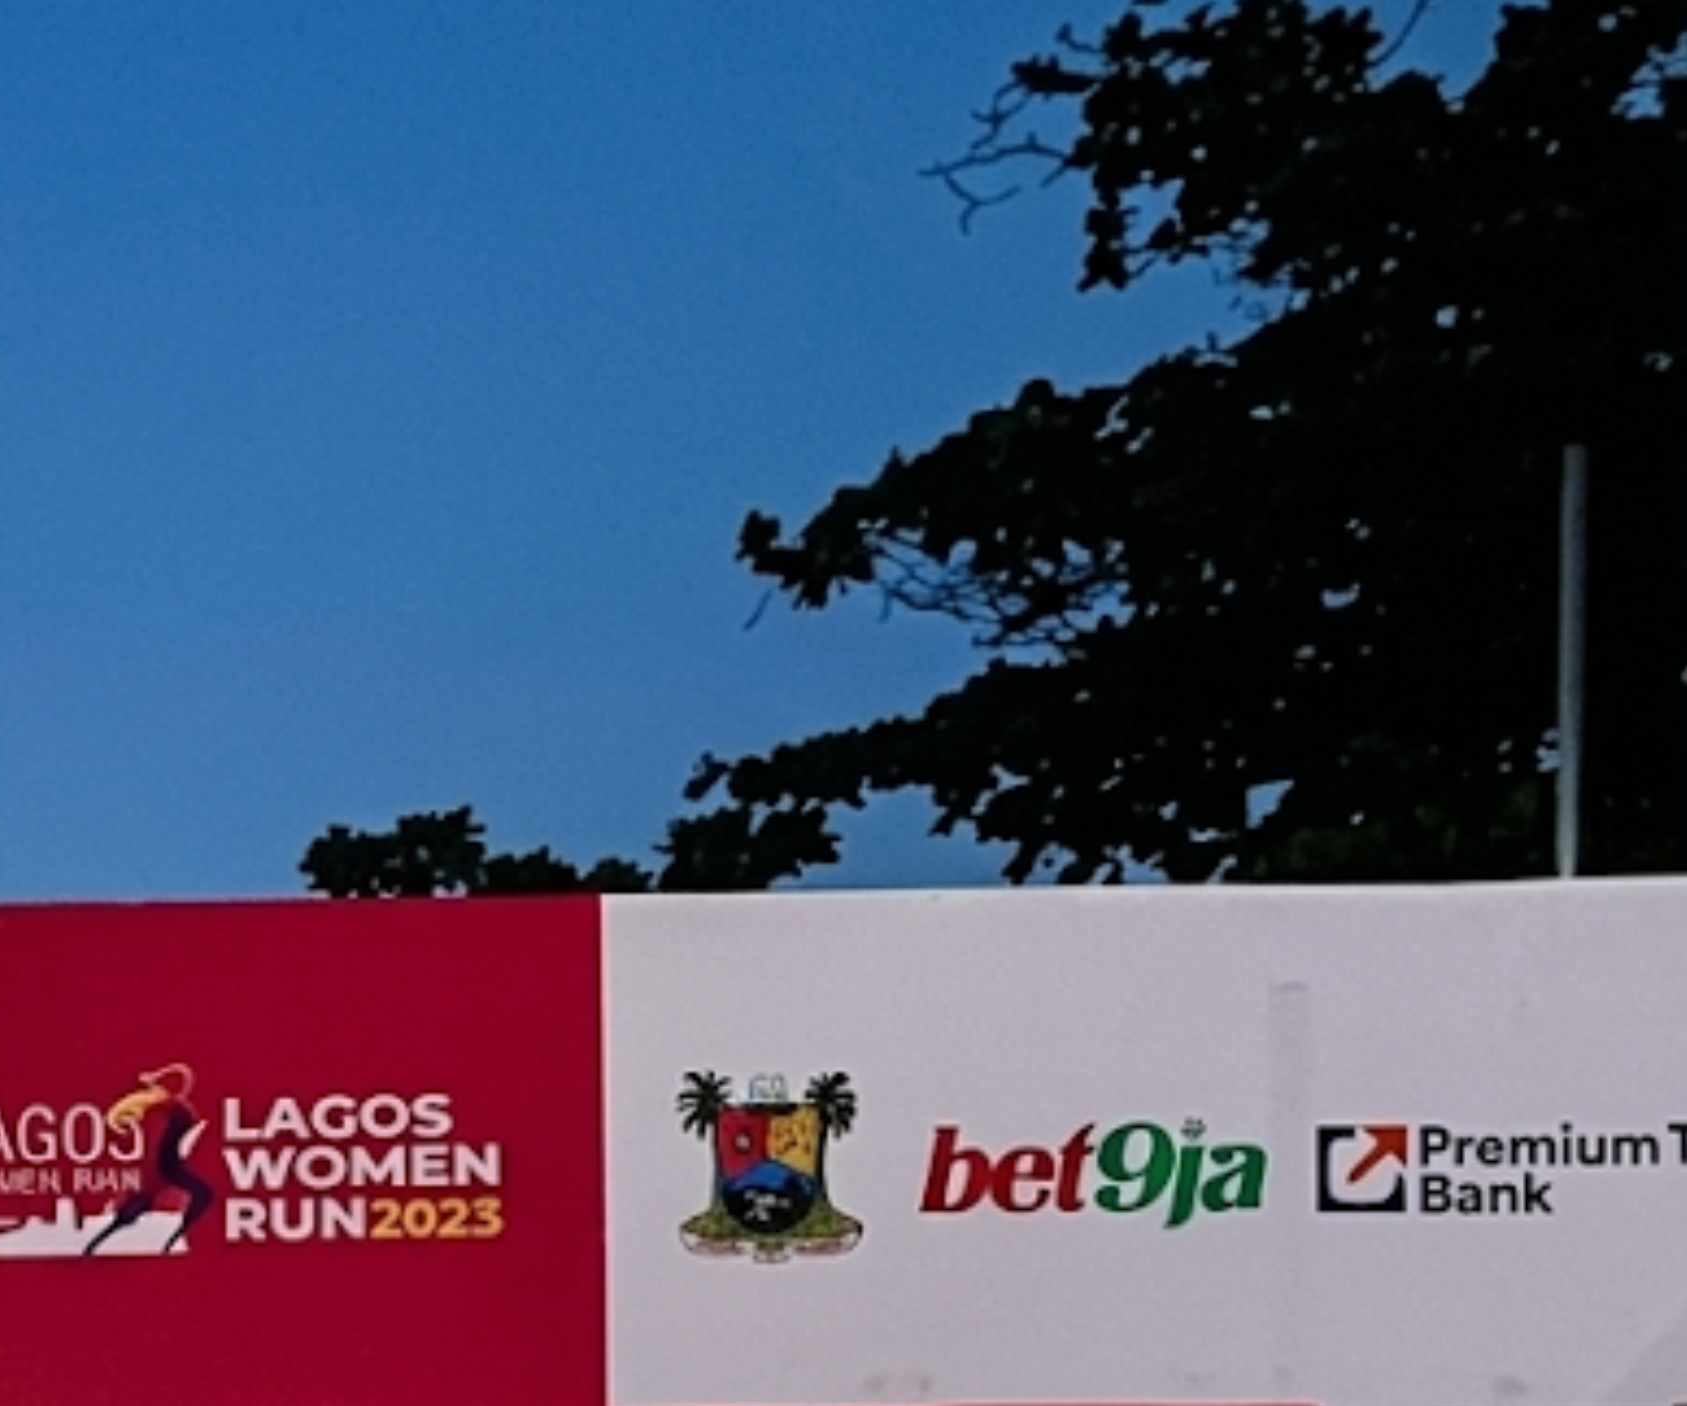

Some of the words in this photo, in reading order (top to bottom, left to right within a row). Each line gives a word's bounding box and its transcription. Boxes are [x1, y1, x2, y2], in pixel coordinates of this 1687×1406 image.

[223, 1094, 454, 1141] LAGOS
[223, 1142, 502, 1191] WOMEN
[1418, 1121, 1661, 1166] Premium
[919, 1118, 1268, 1230] bet9ja
[1418, 1171, 1554, 1215] Bank
